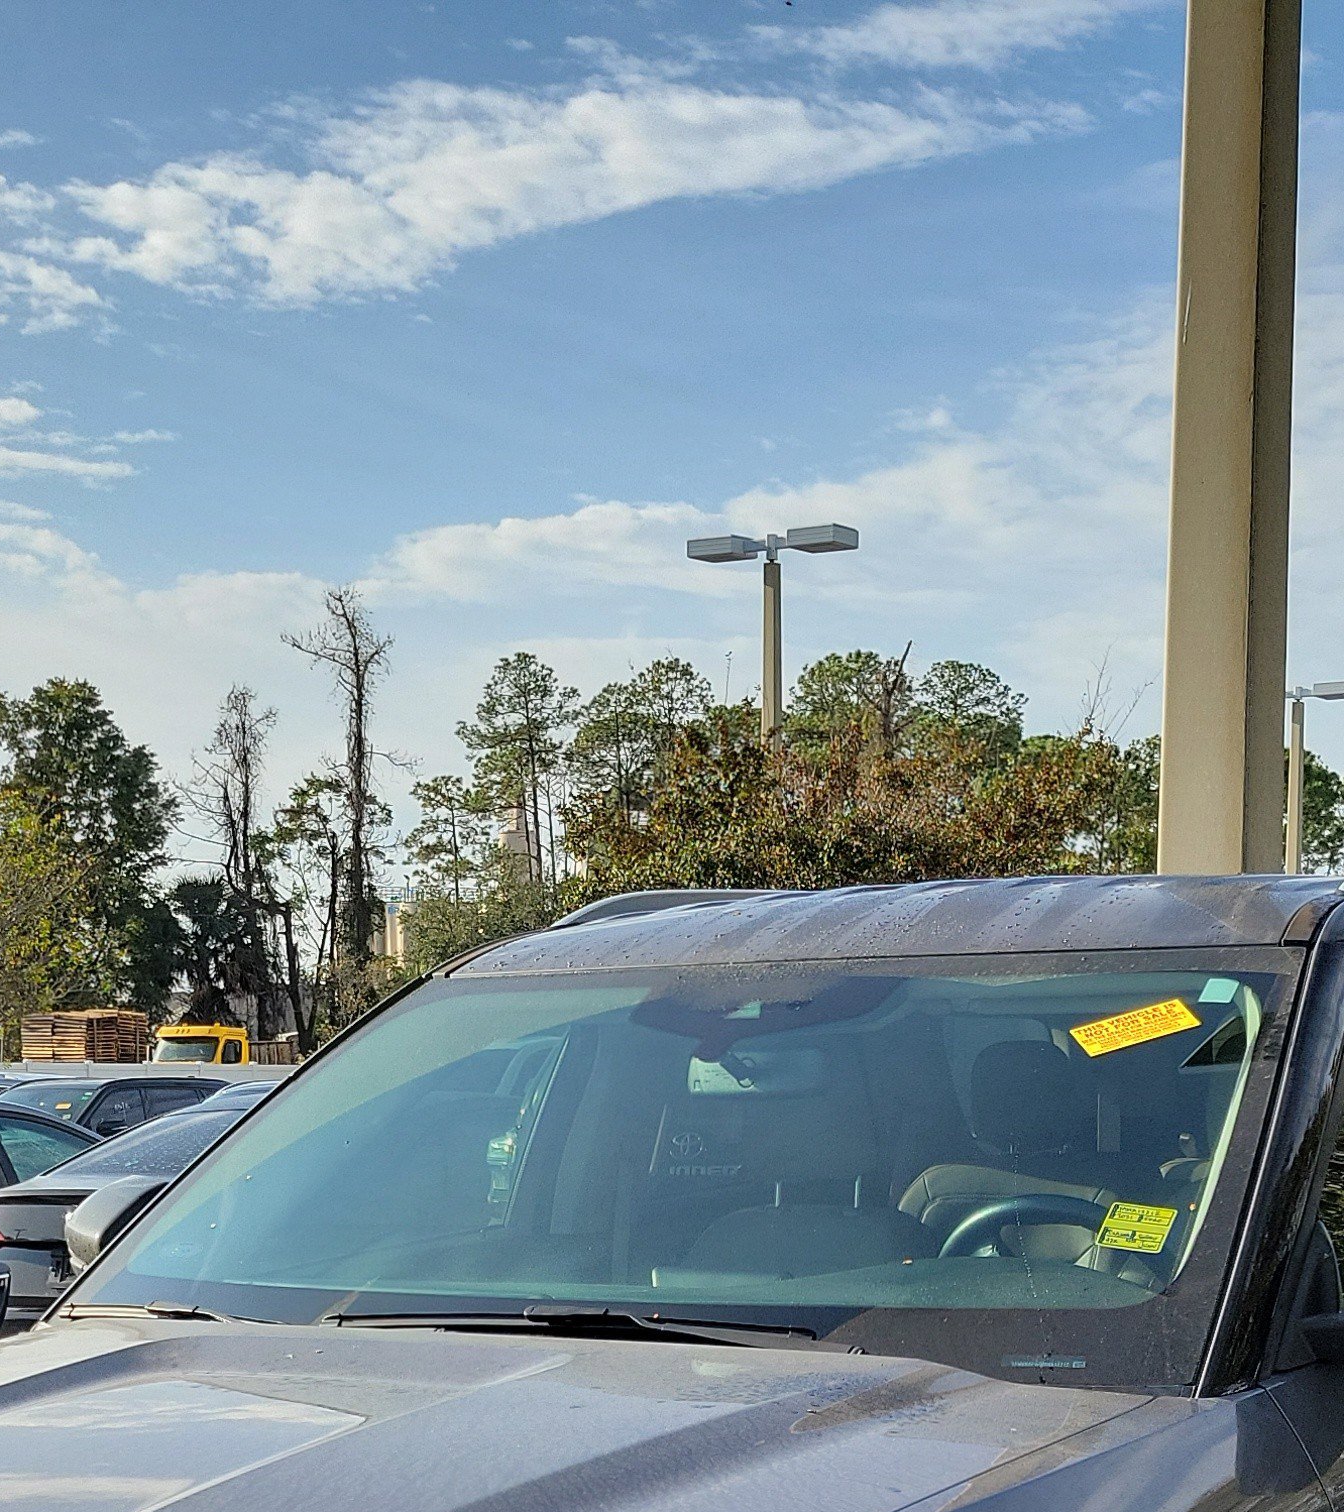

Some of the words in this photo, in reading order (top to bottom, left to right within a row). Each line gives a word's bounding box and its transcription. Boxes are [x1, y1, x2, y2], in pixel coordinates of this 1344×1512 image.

[1075, 1023, 1105, 1035] THIS
[1106, 1006, 1162, 1027] VEHICLE
[1084, 1026, 1111, 1039] NOT
[1113, 1018, 1140, 1031] FOR
[1142, 1008, 1176, 1022] SALE
